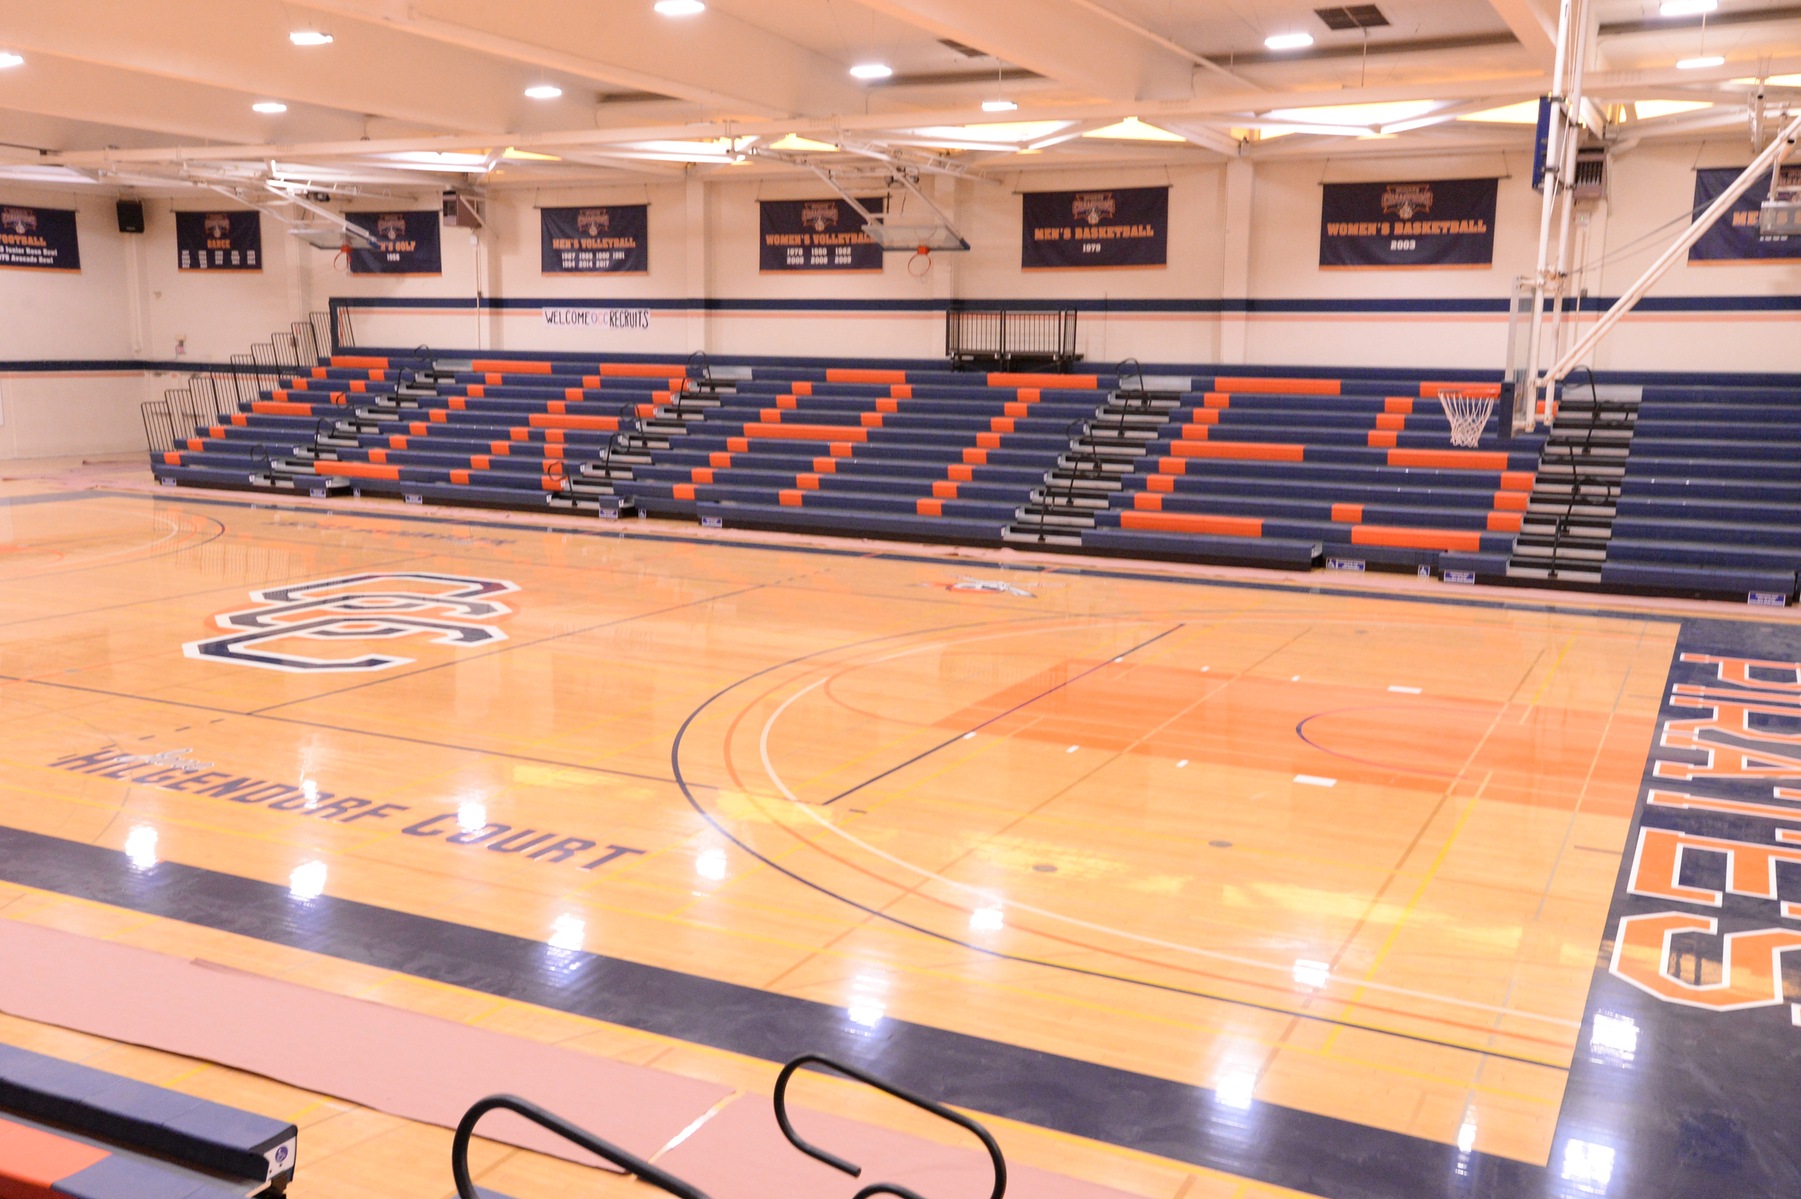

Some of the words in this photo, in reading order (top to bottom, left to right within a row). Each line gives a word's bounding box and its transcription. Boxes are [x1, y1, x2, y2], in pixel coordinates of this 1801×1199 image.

[1035, 228, 1071, 241] MEN'S
[1075, 224, 1154, 239] BASKETBALL
[1327, 221, 1390, 236] WOMEN'S
[1394, 219, 1487, 235] BASKETBALL
[0, 234, 47, 247] OOTBALL
[395, 241, 416, 251] GOLF
[553, 238, 579, 250] MEN'S
[580, 236, 636, 249] VOLLEYBALL
[766, 234, 810, 245] WOMEN'S
[545, 310, 590, 325] WELCOME
[609, 310, 649, 328] RECRUITS
[402, 812, 646, 870] COURT
